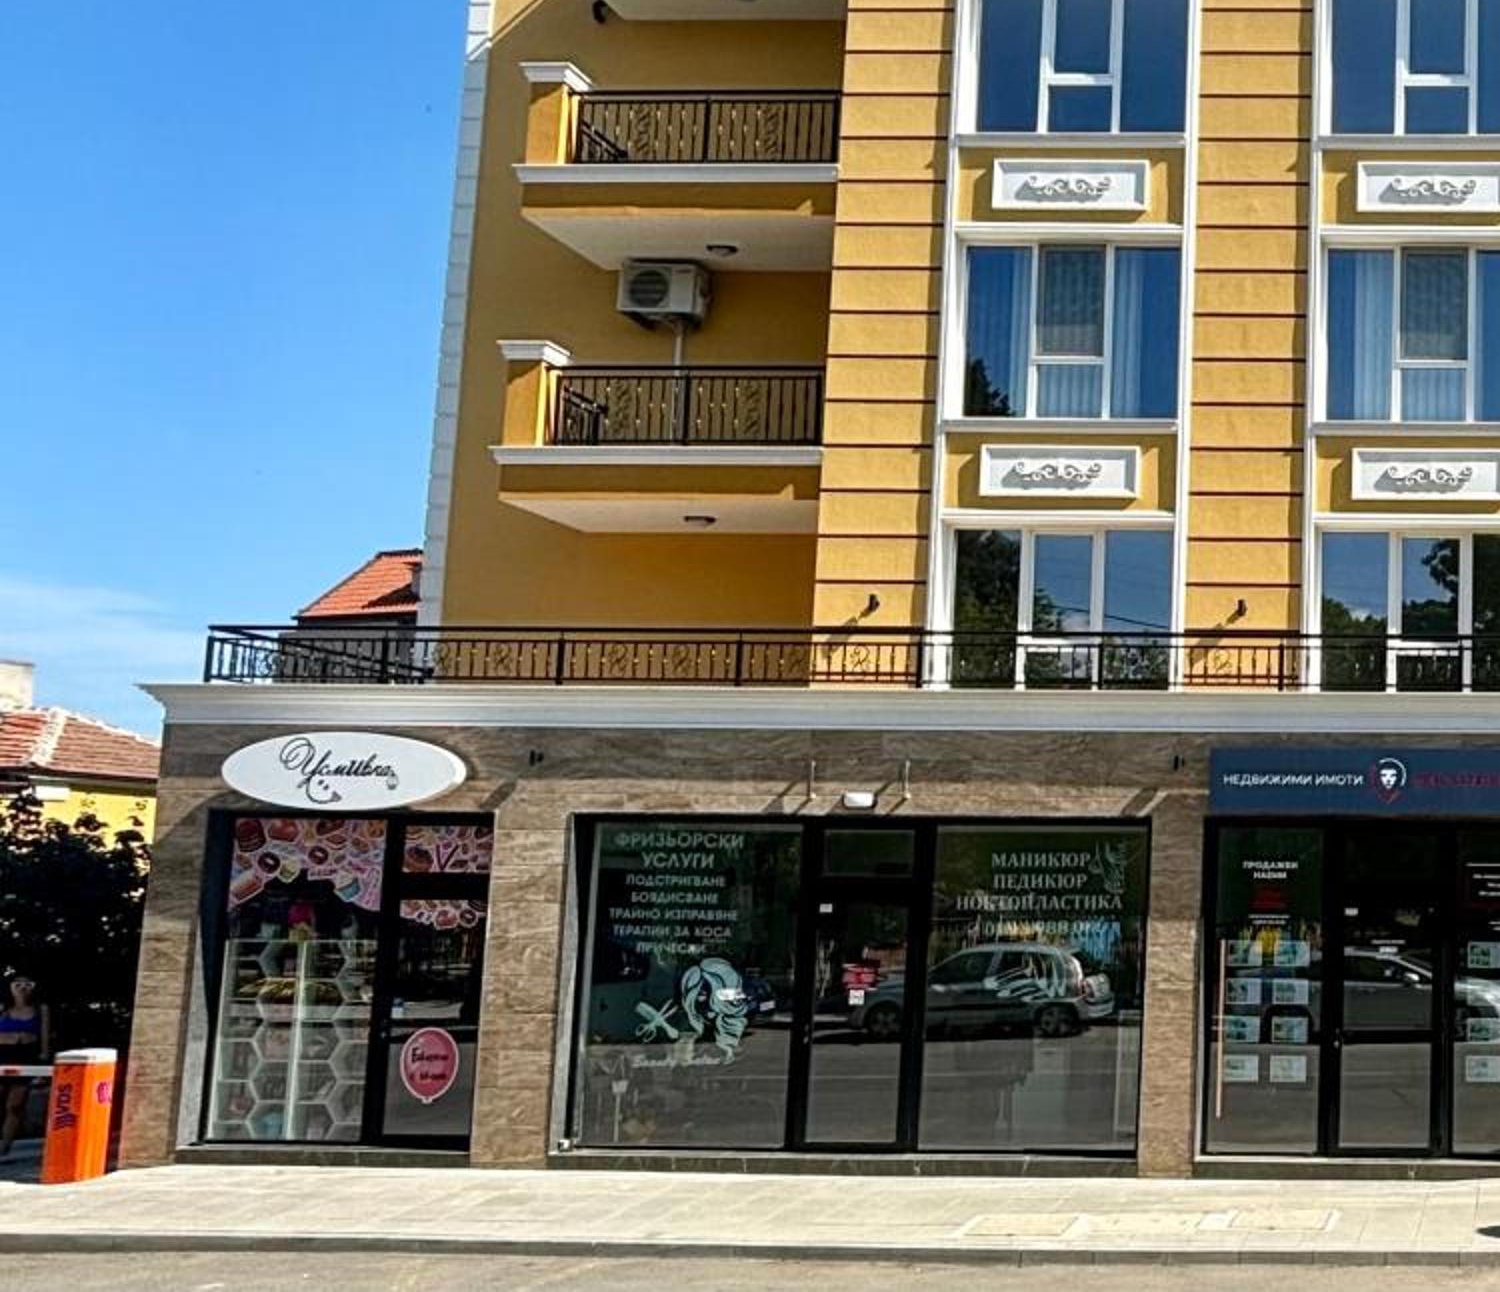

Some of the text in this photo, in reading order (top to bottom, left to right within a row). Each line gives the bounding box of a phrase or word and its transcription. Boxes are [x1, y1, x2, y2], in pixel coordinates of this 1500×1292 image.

[1223, 772, 1364, 788] НЕДВИЖИМИ ИМОТИ
[613, 831, 745, 849] ФРИЗЬОРСКИ
[641, 851, 715, 869] УСЛУГИ
[991, 851, 1091, 868] МАНИКЮР
[625, 873, 727, 888] ПОДСТРИГВАНЕ
[993, 872, 1088, 891] ПЕДИКЮР
[631, 891, 719, 905] БОЯДИСВАНЕ
[956, 892, 1122, 911] НОКТОПЛАСТИКА
[609, 907, 661, 920] ТРАЙНО
[674, 925, 690, 937] ЗА
[694, 926, 732, 938] КОСА
